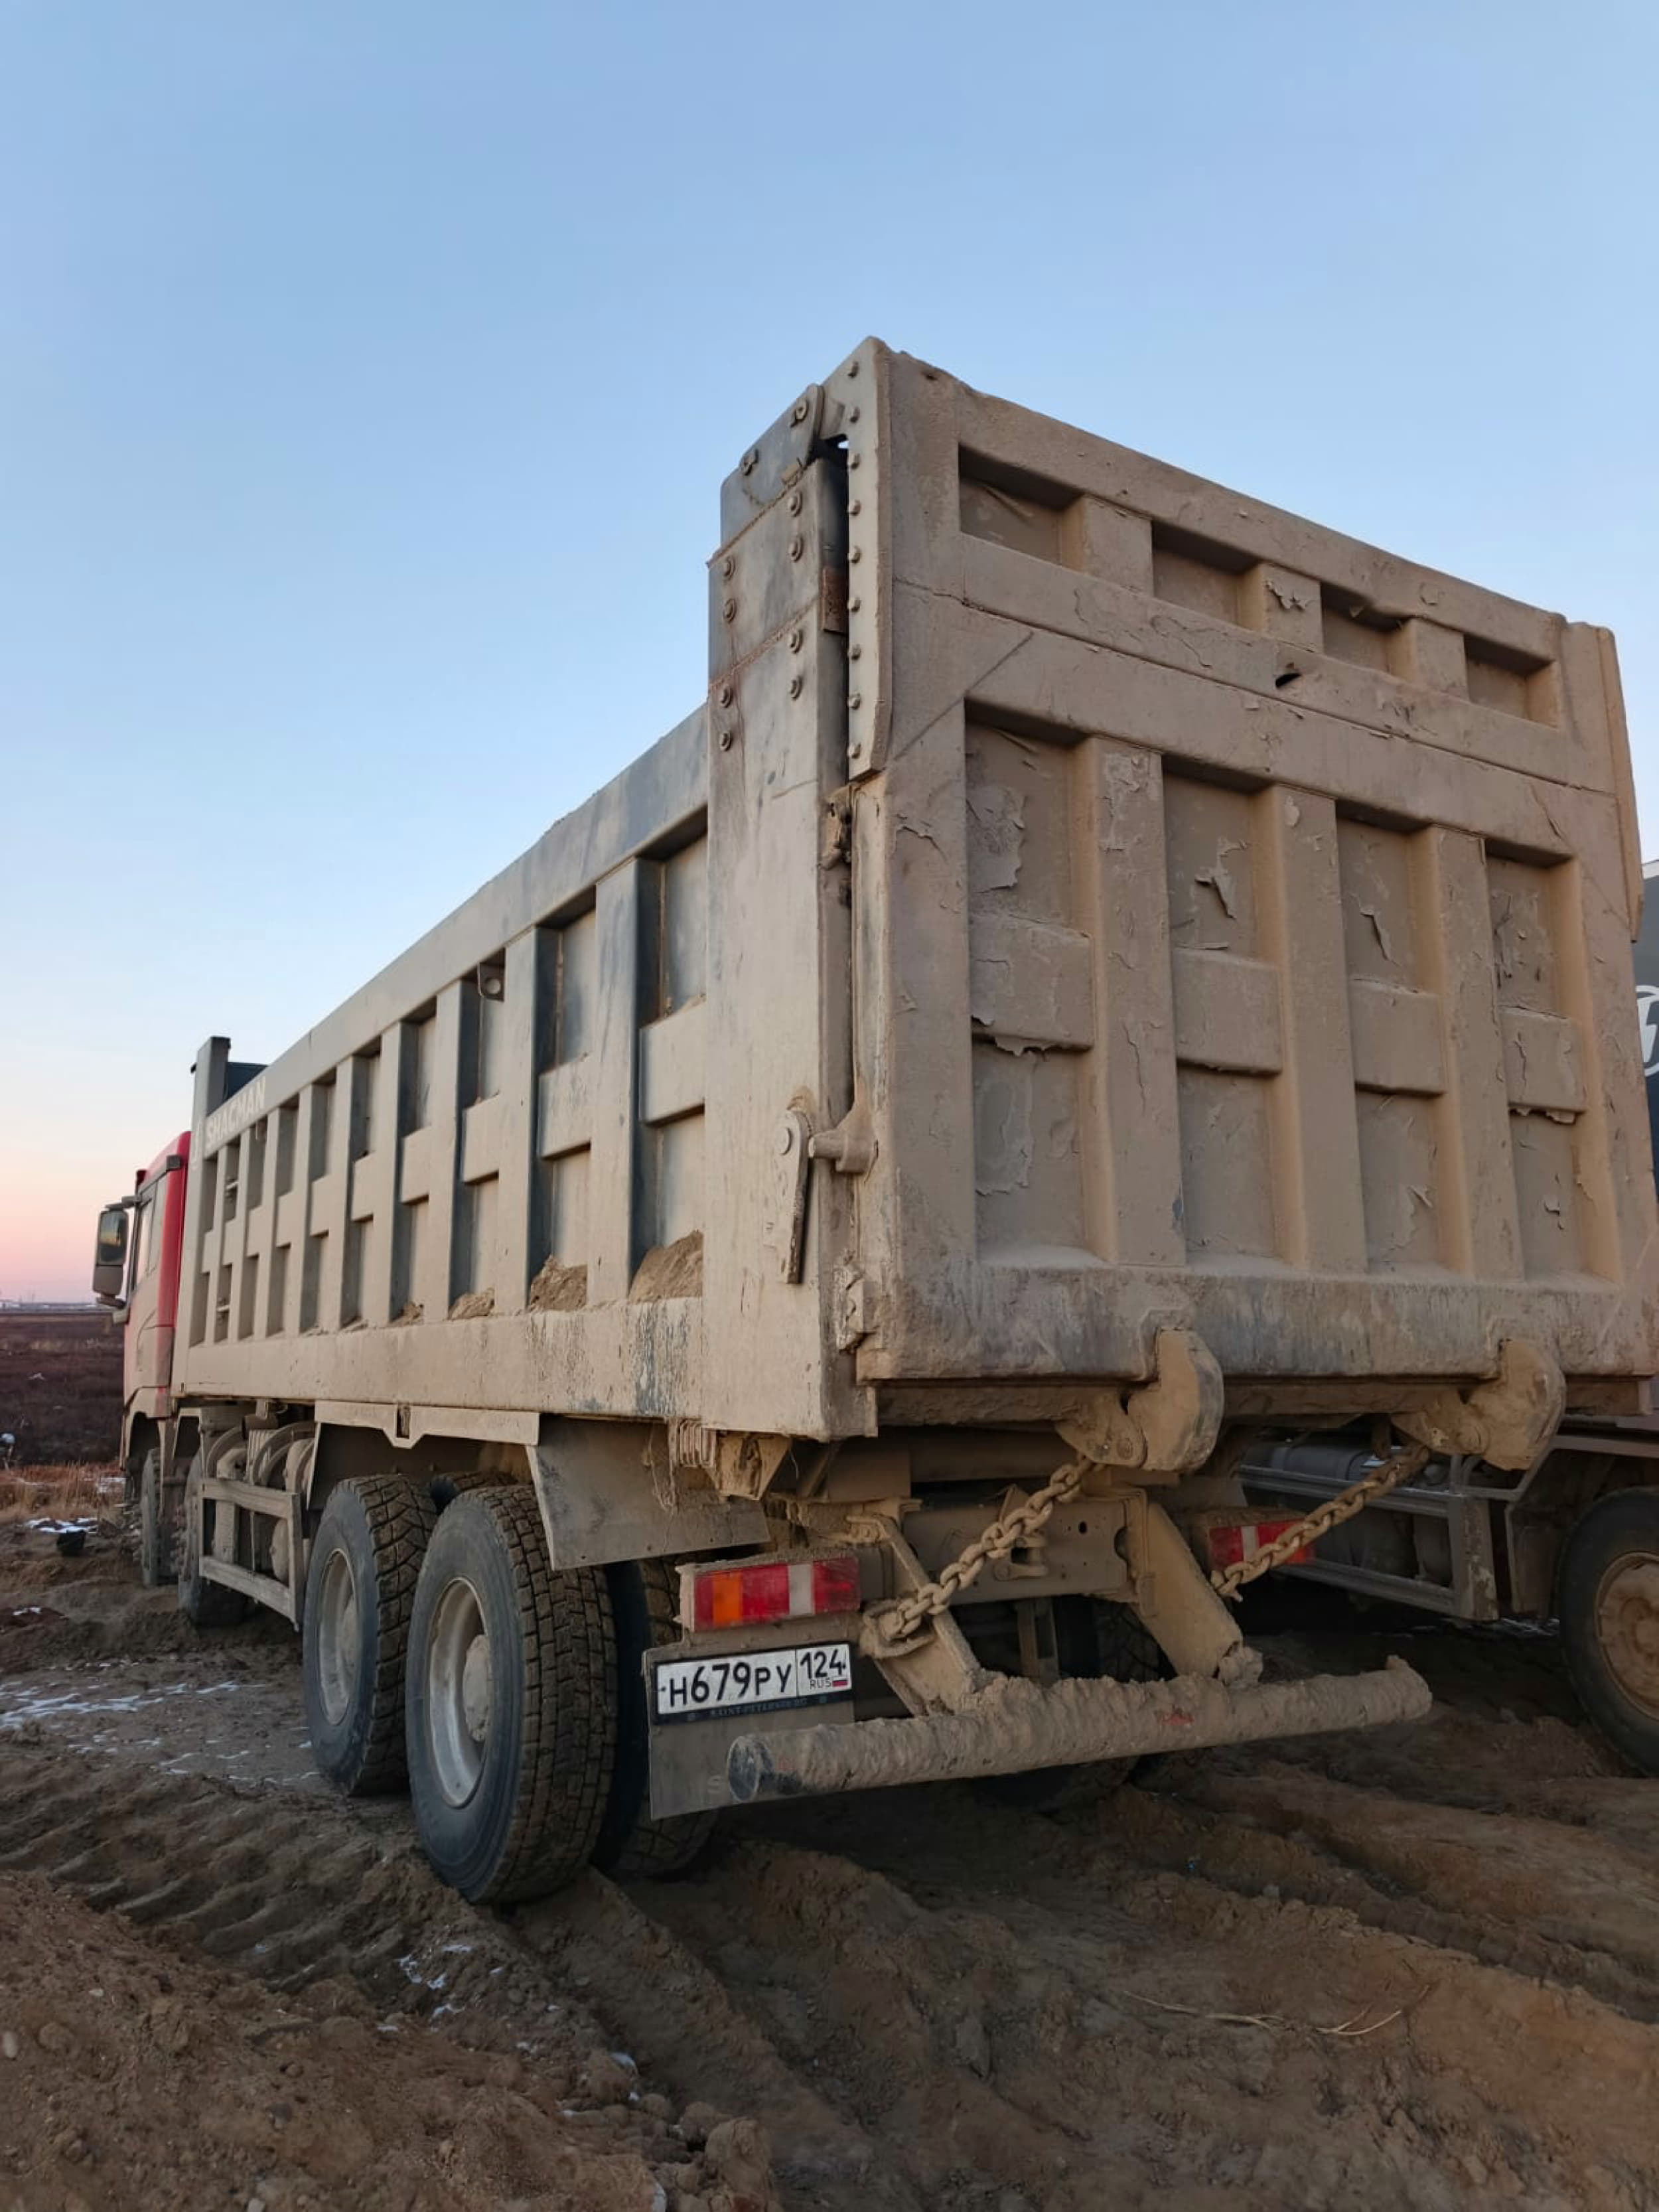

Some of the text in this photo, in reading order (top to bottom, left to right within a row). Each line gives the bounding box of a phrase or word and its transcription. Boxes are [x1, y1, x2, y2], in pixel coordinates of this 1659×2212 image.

[205, 1075, 266, 1148] SHACMAN
[800, 1649, 842, 1679] 124
[810, 1678, 831, 1690] RUS
